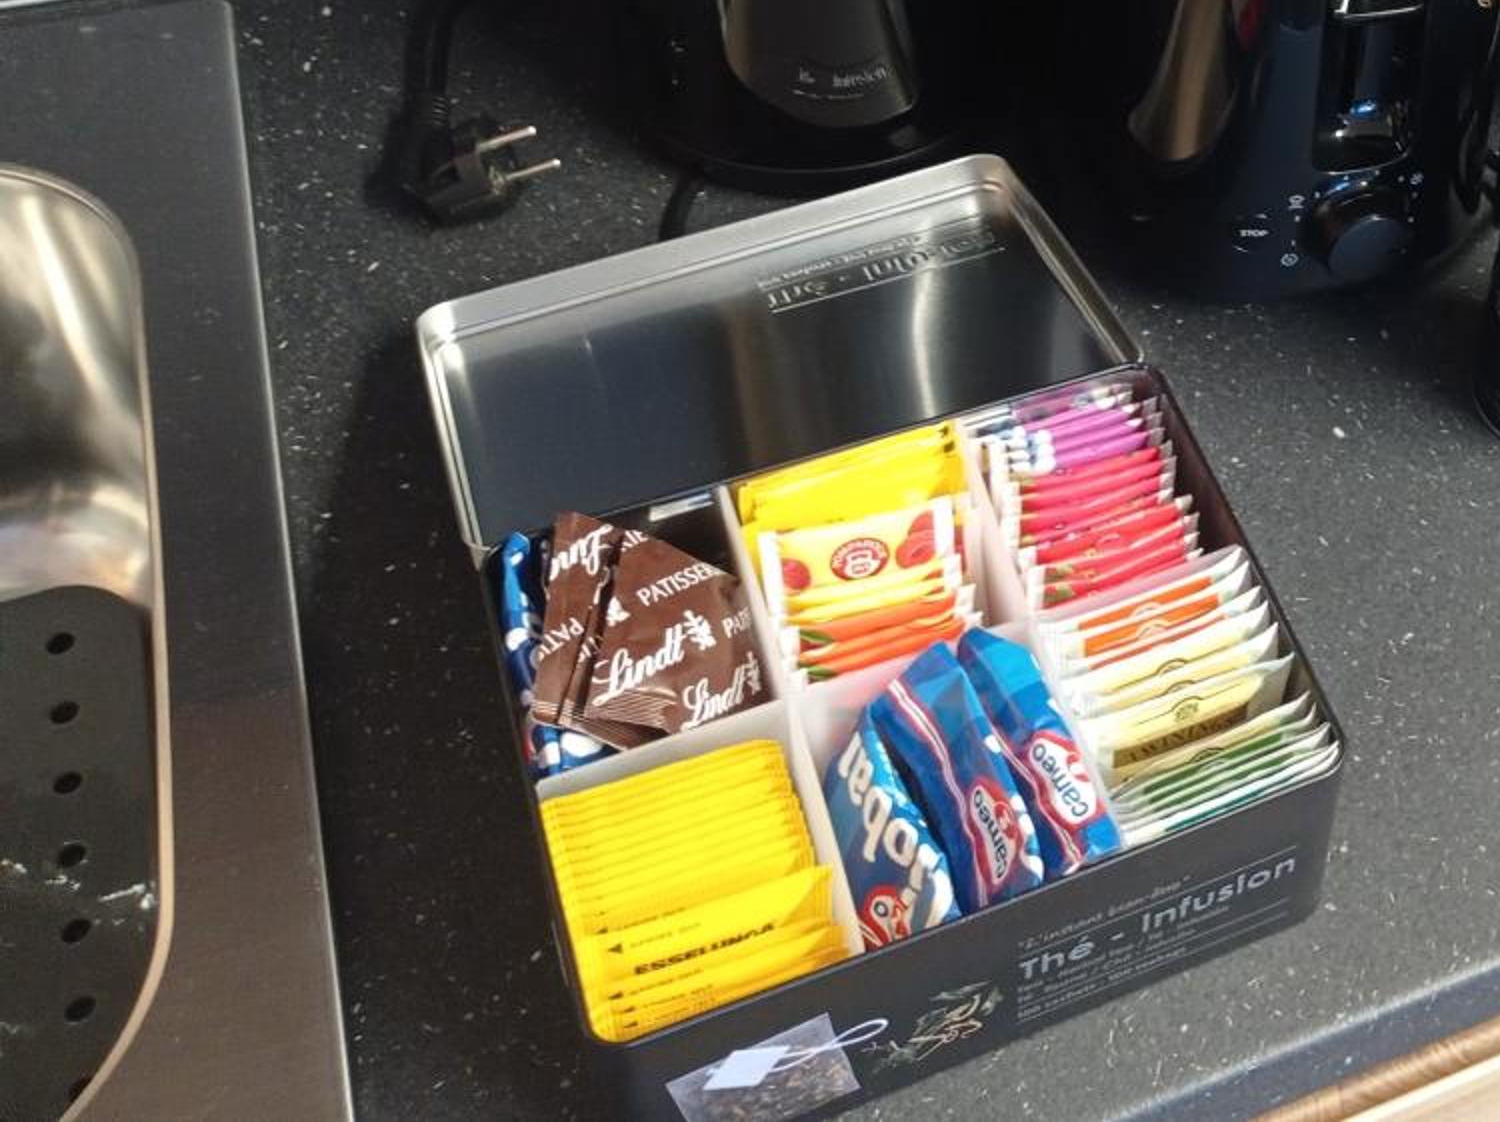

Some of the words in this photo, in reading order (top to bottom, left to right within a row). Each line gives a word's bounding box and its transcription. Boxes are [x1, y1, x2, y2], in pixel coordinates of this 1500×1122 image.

[1239, 229, 1268, 238] STOP
[592, 622, 686, 707] Lindt
[680, 659, 747, 731] Lindt
[1032, 742, 1090, 818] cameo
[973, 788, 1009, 880] cameo
[1019, 933, 1095, 980] Thé
[1141, 857, 1297, 933] Infusion
